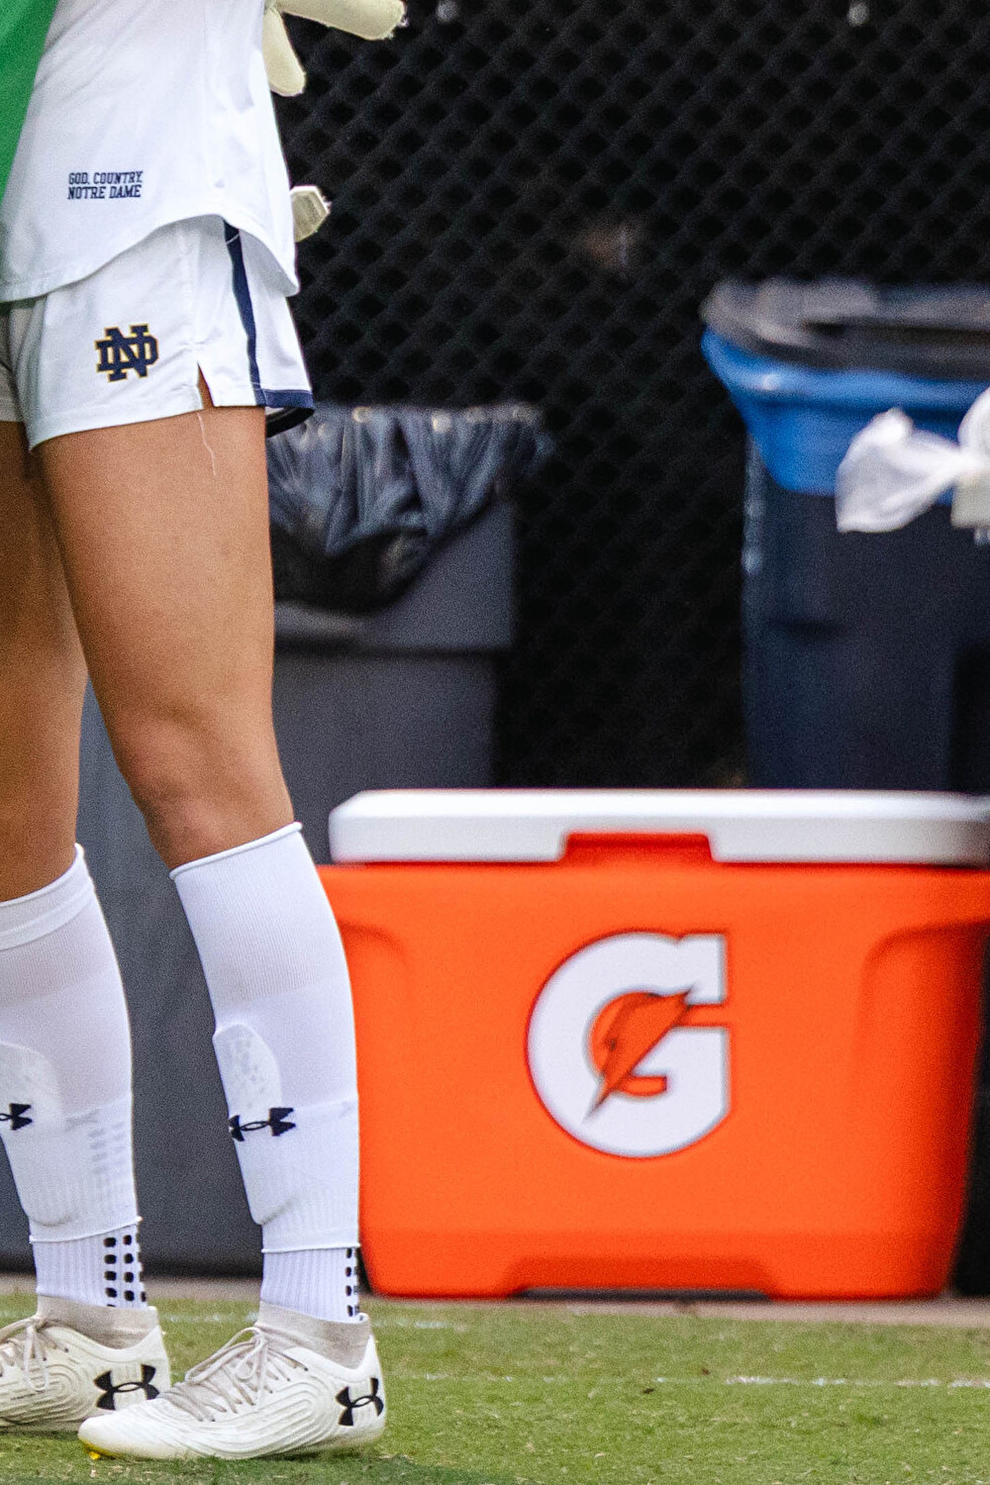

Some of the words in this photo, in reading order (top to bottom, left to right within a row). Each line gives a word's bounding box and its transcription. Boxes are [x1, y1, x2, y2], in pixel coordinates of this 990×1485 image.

[67, 186, 106, 200] NOTRE
[109, 184, 141, 199] DAME
[526, 930, 731, 1158] G
